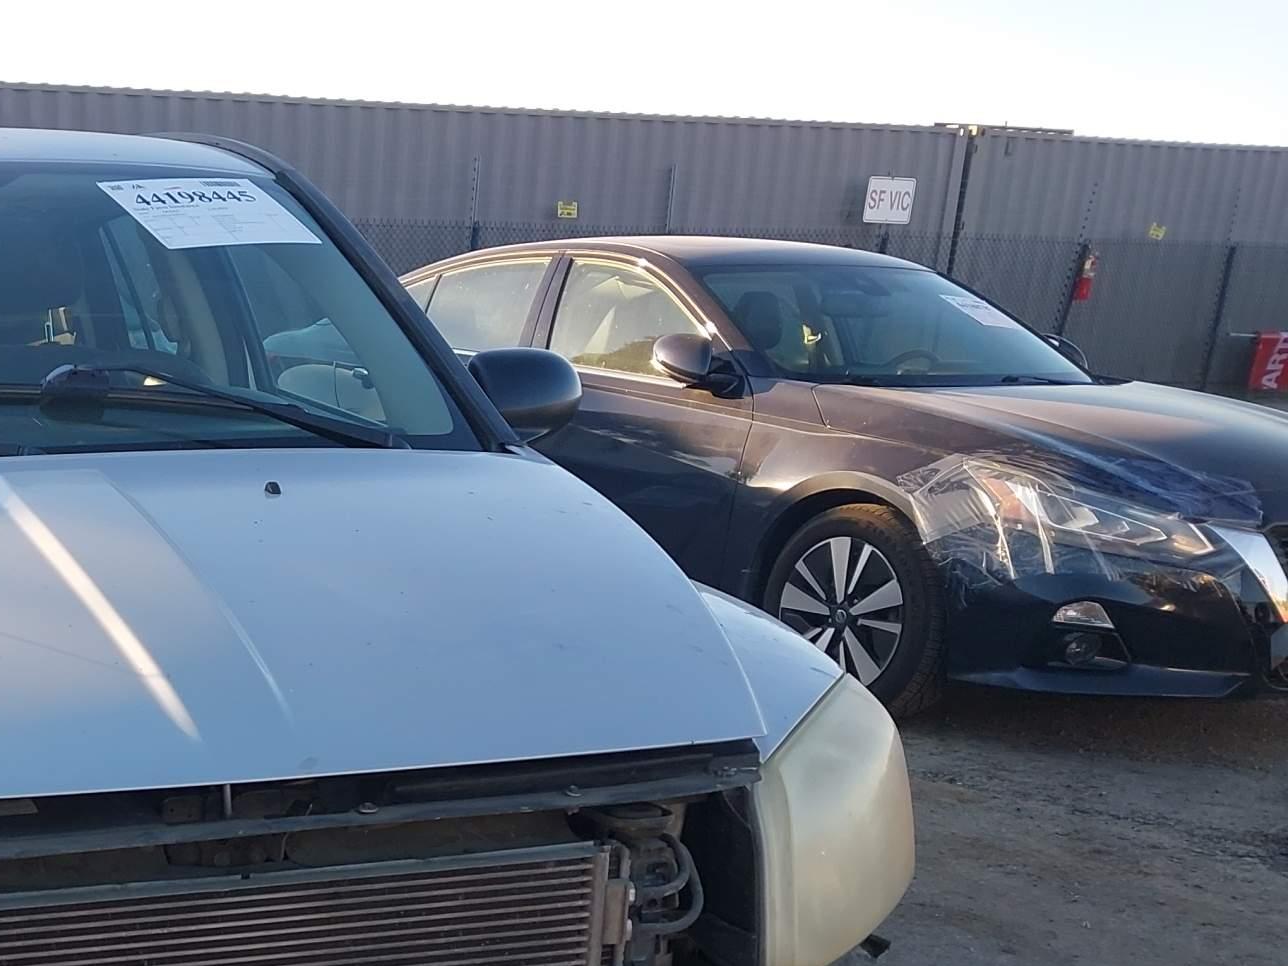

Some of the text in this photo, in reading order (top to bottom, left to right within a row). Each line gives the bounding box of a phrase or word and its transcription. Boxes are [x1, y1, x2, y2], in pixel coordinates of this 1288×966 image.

[135, 191, 257, 206] 44198445
[868, 190, 911, 211] SF VIC
[1261, 332, 1288, 390] ART
